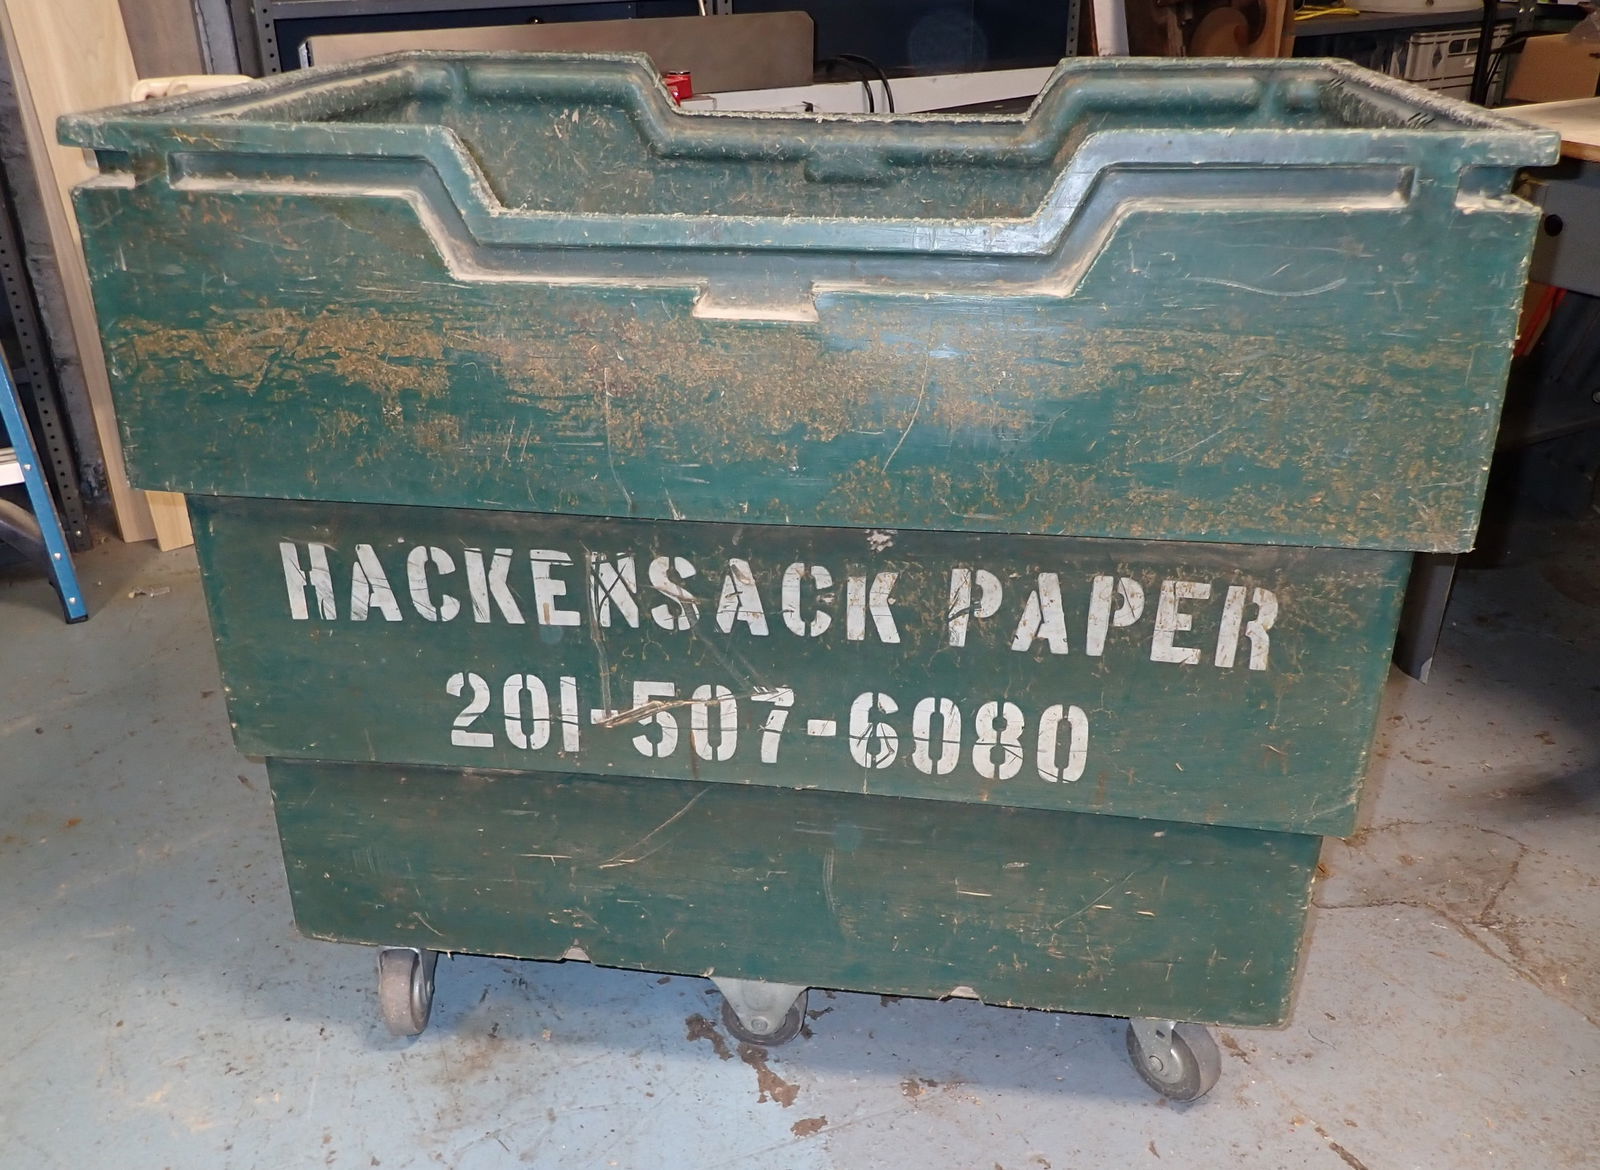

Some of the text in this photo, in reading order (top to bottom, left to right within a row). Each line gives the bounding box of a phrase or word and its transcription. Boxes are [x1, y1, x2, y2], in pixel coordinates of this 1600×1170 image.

[279, 542, 1279, 671] HACKENSACK PAPER
[445, 672, 1090, 783] 201-507-6080
